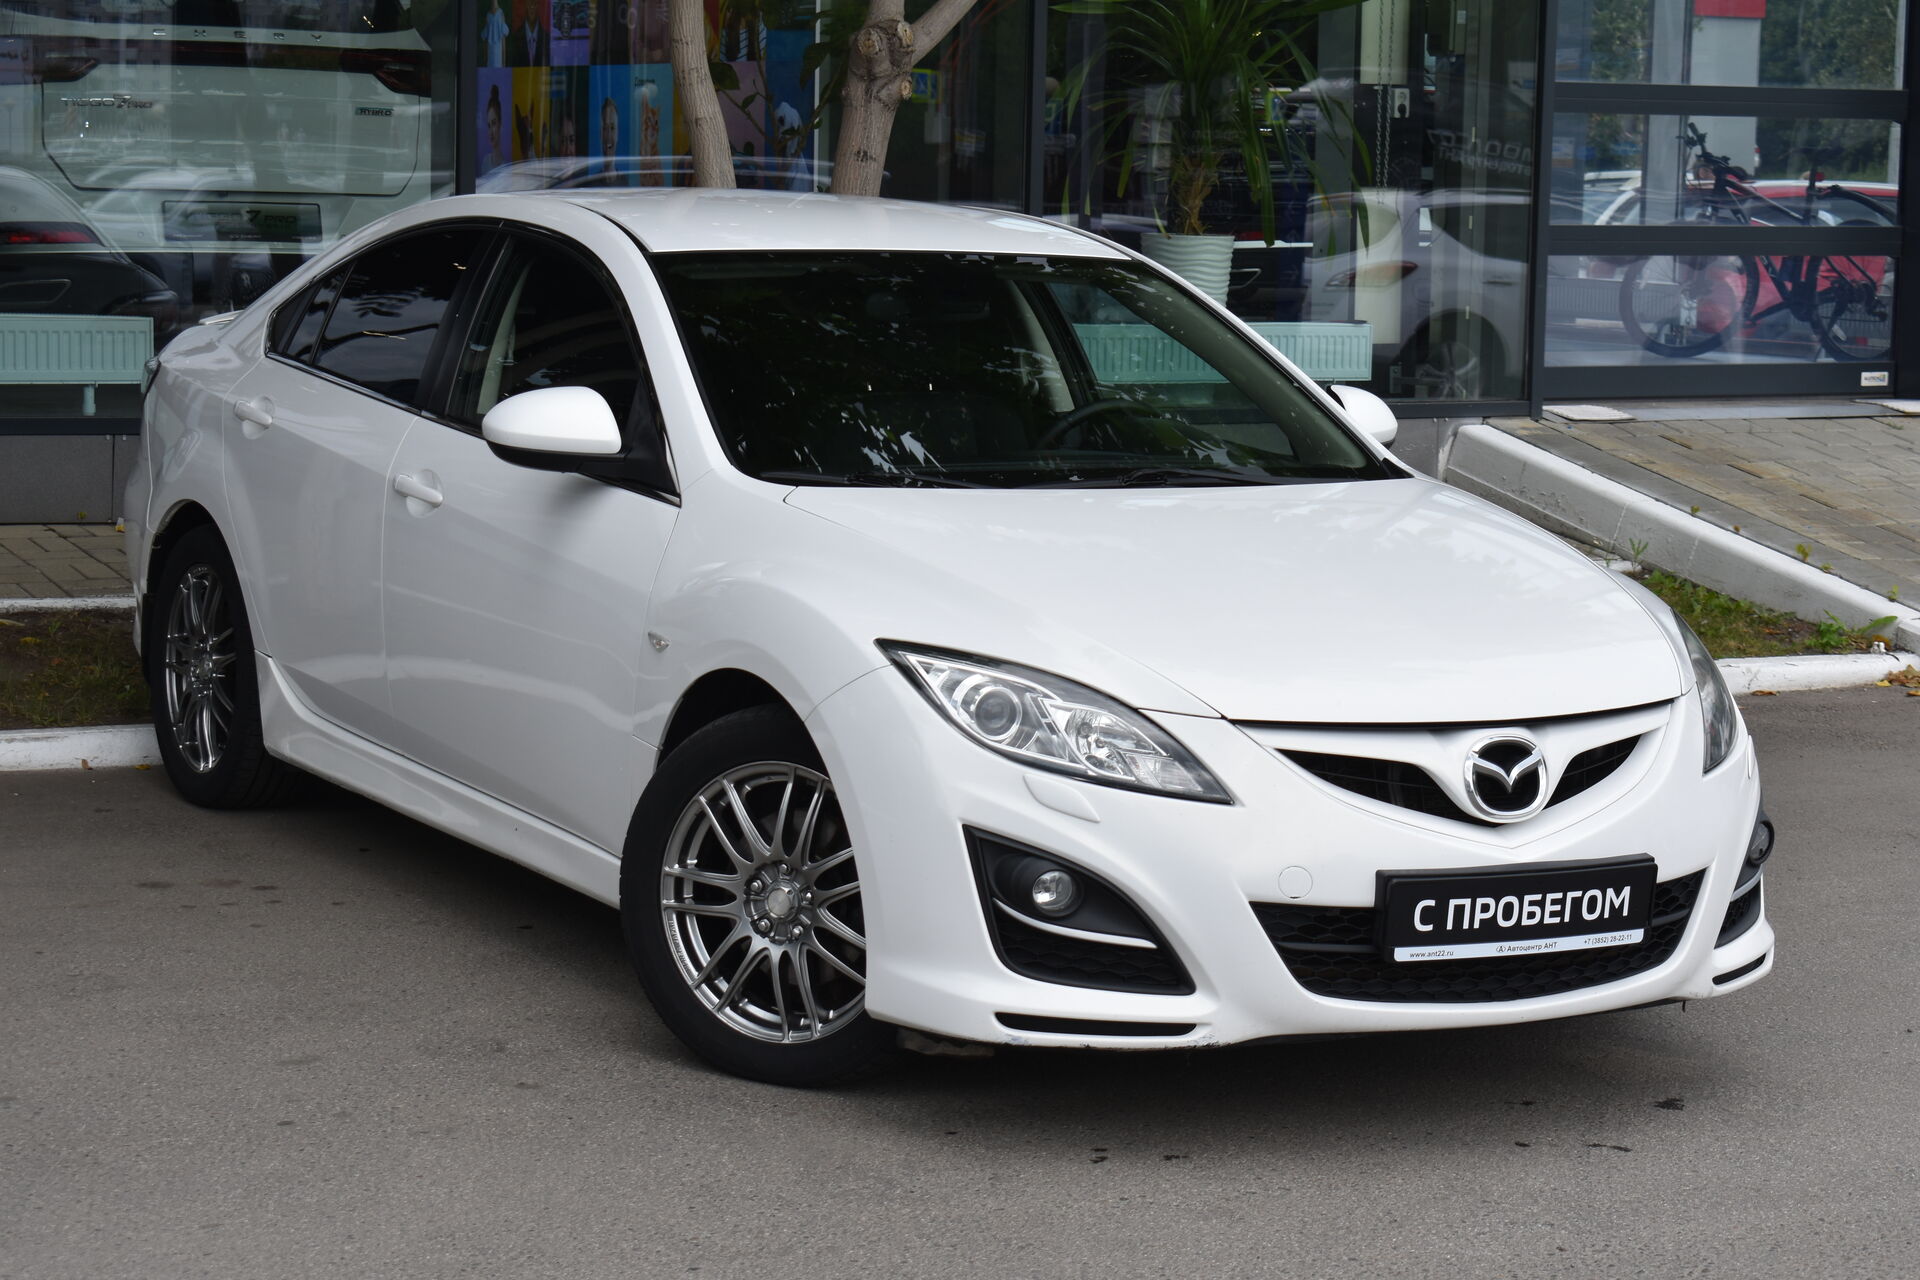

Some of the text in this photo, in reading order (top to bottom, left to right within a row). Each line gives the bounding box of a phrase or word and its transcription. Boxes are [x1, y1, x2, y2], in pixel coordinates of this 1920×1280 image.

[1413, 886, 1631, 932] С ПРОБЕГОМ
[1592, 936, 1609, 945] (3852)
[1610, 934, 1632, 943] 28-22-11
[1507, 942, 1558, 952] Автоцентр АНТ
[1409, 949, 1454, 958] www.ant22.ru
